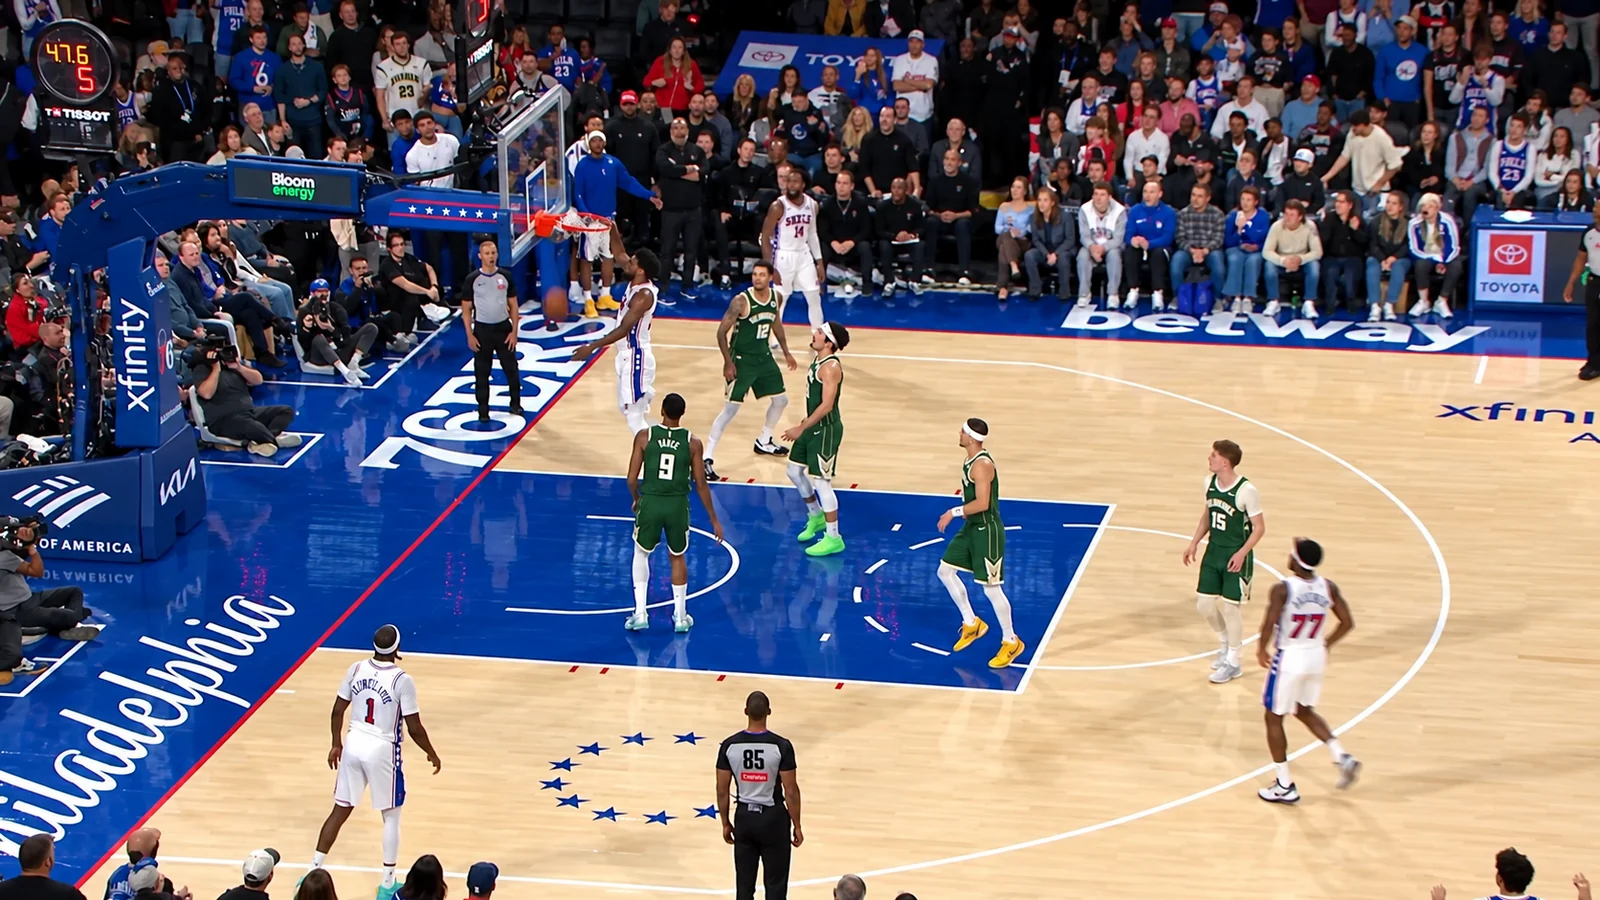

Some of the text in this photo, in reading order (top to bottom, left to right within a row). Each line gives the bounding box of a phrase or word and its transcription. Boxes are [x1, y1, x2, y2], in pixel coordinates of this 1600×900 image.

[230, 18, 240, 31] 21
[805, 53, 896, 68] TOYT
[78, 67, 94, 91] 5
[555, 66, 570, 77] 23
[398, 85, 415, 98] 23
[62, 108, 110, 121] TISSOT
[271, 172, 315, 188] Bloom
[272, 186, 315, 201] energy
[794, 225, 804, 238] 14
[1479, 281, 1540, 294] TOYOTA
[756, 323, 770, 340] 12
[1060, 303, 1492, 352] betway
[115, 298, 155, 413] xfinity
[359, 314, 617, 469] 76ERS
[658, 453, 675, 480] 9
[159, 457, 196, 506] KIA
[1211, 511, 1227, 531] 15
[39, 538, 133, 554] OF AMERICA
[1288, 613, 1326, 639] 77
[364, 697, 375, 725] 1
[0, 595, 295, 858] iladelphia
[743, 749, 765, 770] 85
